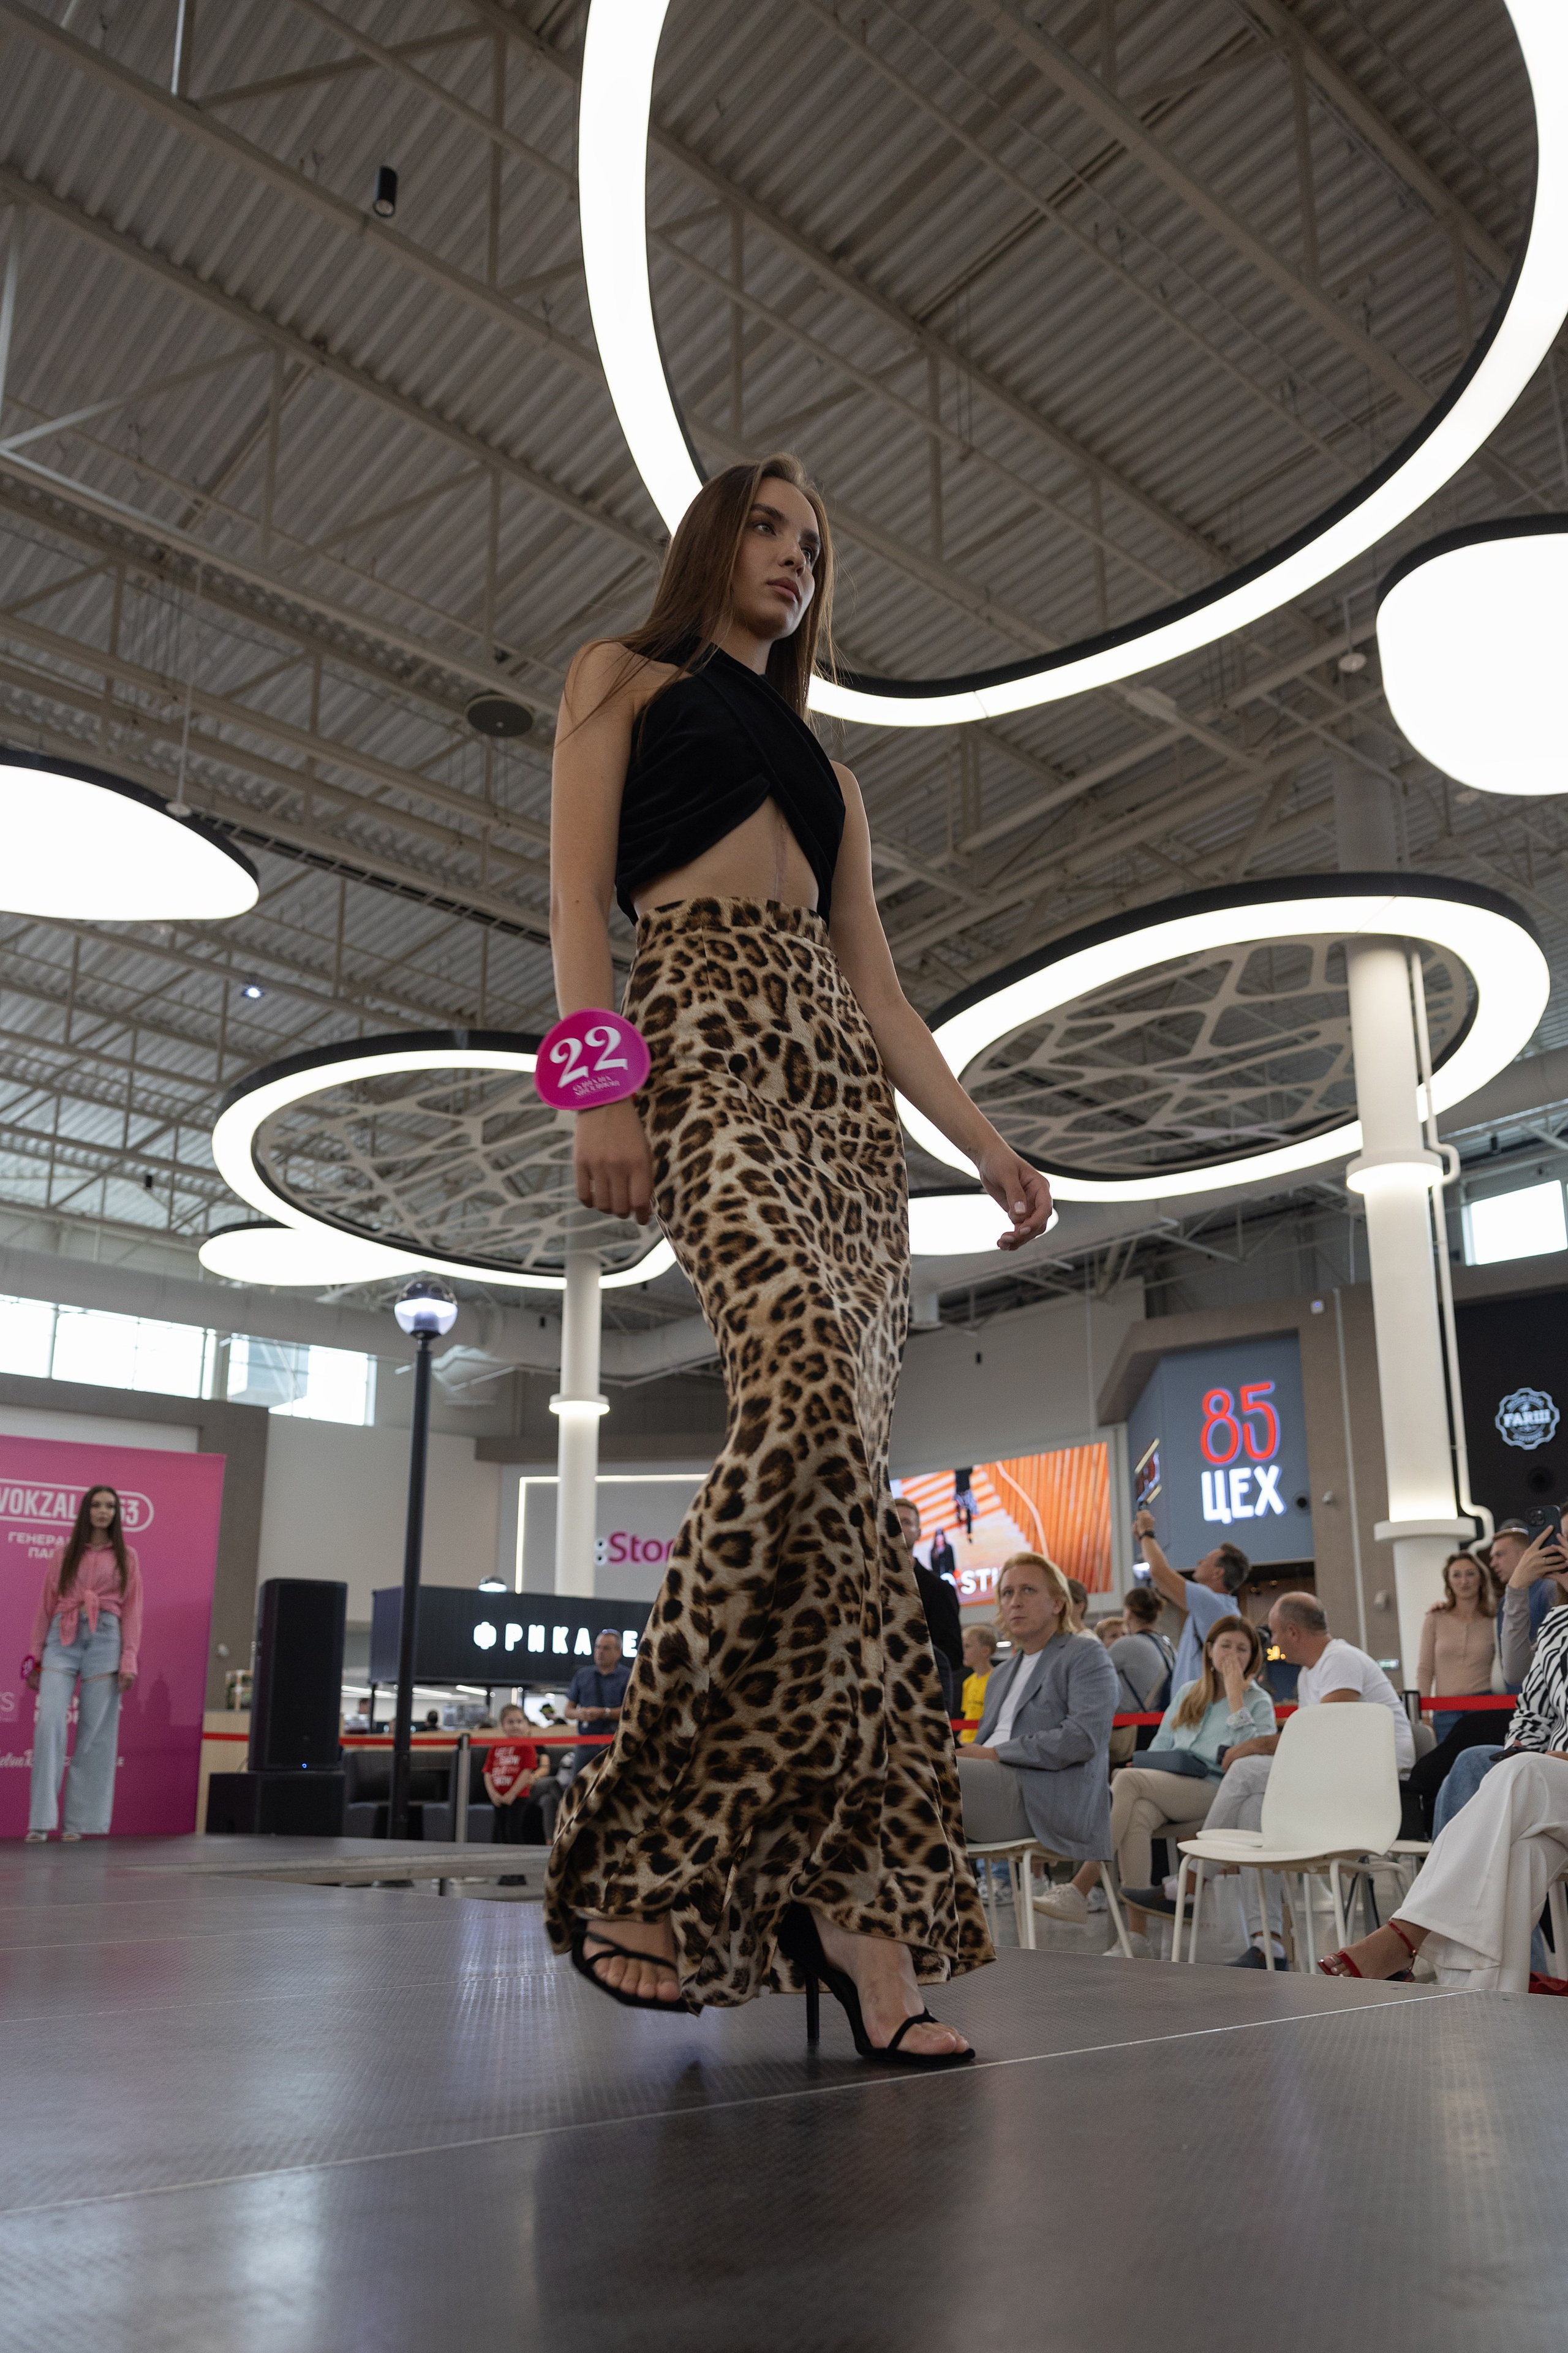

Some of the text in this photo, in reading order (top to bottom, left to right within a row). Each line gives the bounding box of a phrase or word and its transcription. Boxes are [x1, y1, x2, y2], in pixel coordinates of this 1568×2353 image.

[549, 1026, 628, 1088] 22
[1200, 1381, 1278, 1465] 85
[1201, 1465, 1285, 1524] ЦЕХ
[473, 1622, 638, 1658] ФРИКАЕ
